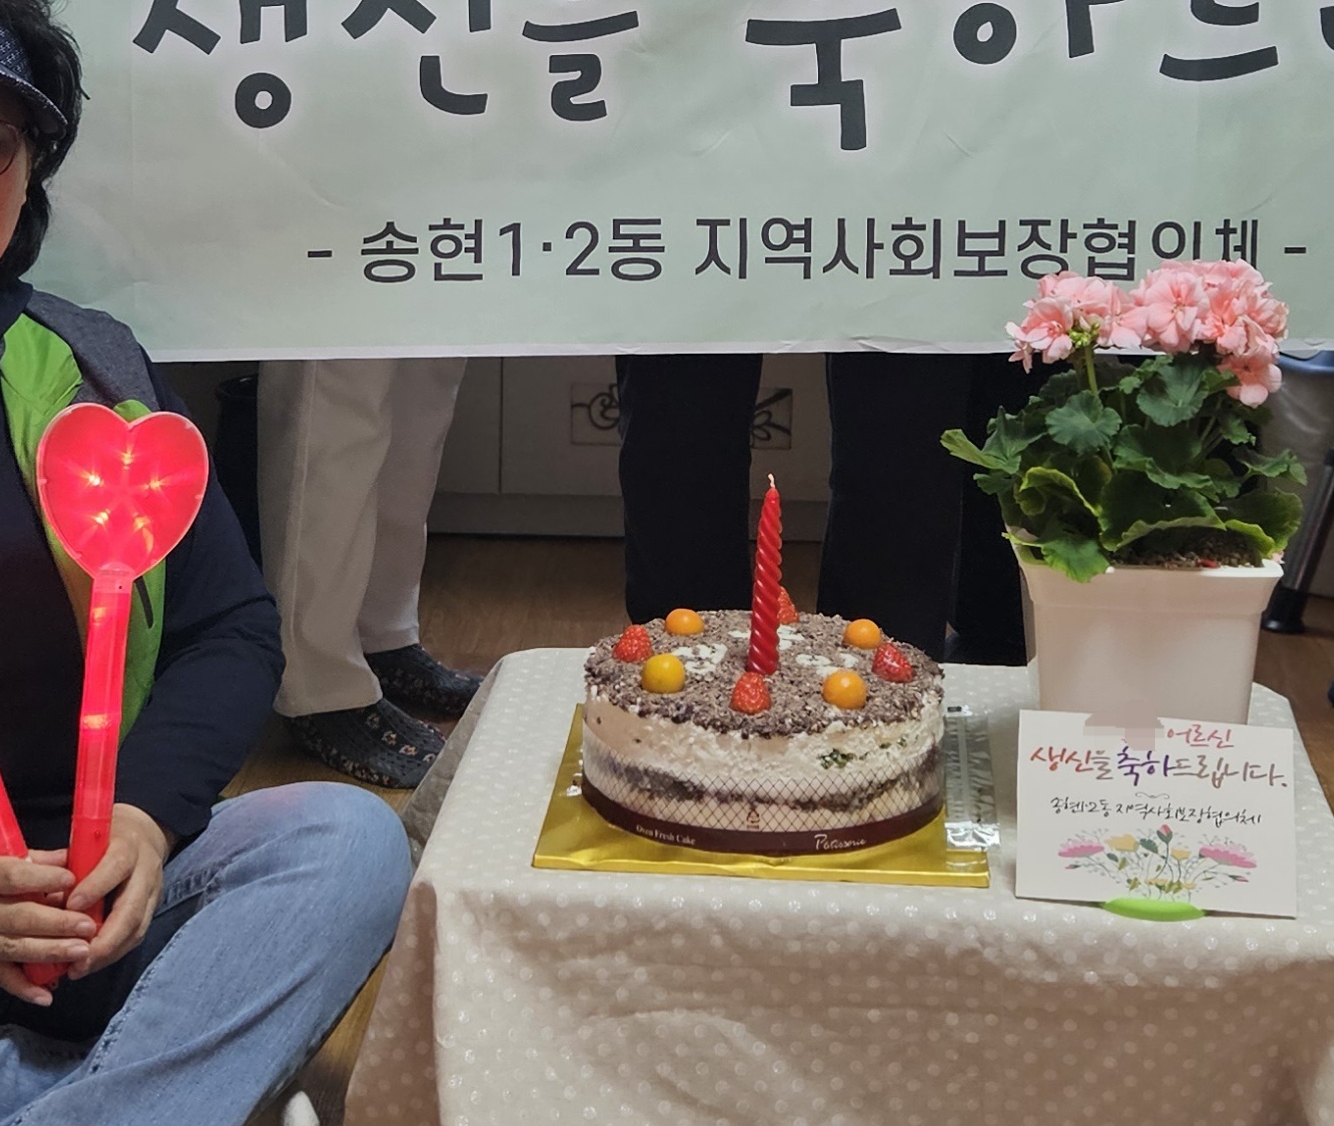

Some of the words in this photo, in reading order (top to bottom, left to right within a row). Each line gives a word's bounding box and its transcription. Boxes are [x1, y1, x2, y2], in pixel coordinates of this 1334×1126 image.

[360, 217, 666, 283] 송현1·2동
[1167, 724, 1234, 748] 어르신
[1030, 746, 1115, 780] 생신을
[654, 829, 675, 842] Fresh
[676, 834, 696, 845] Cake
